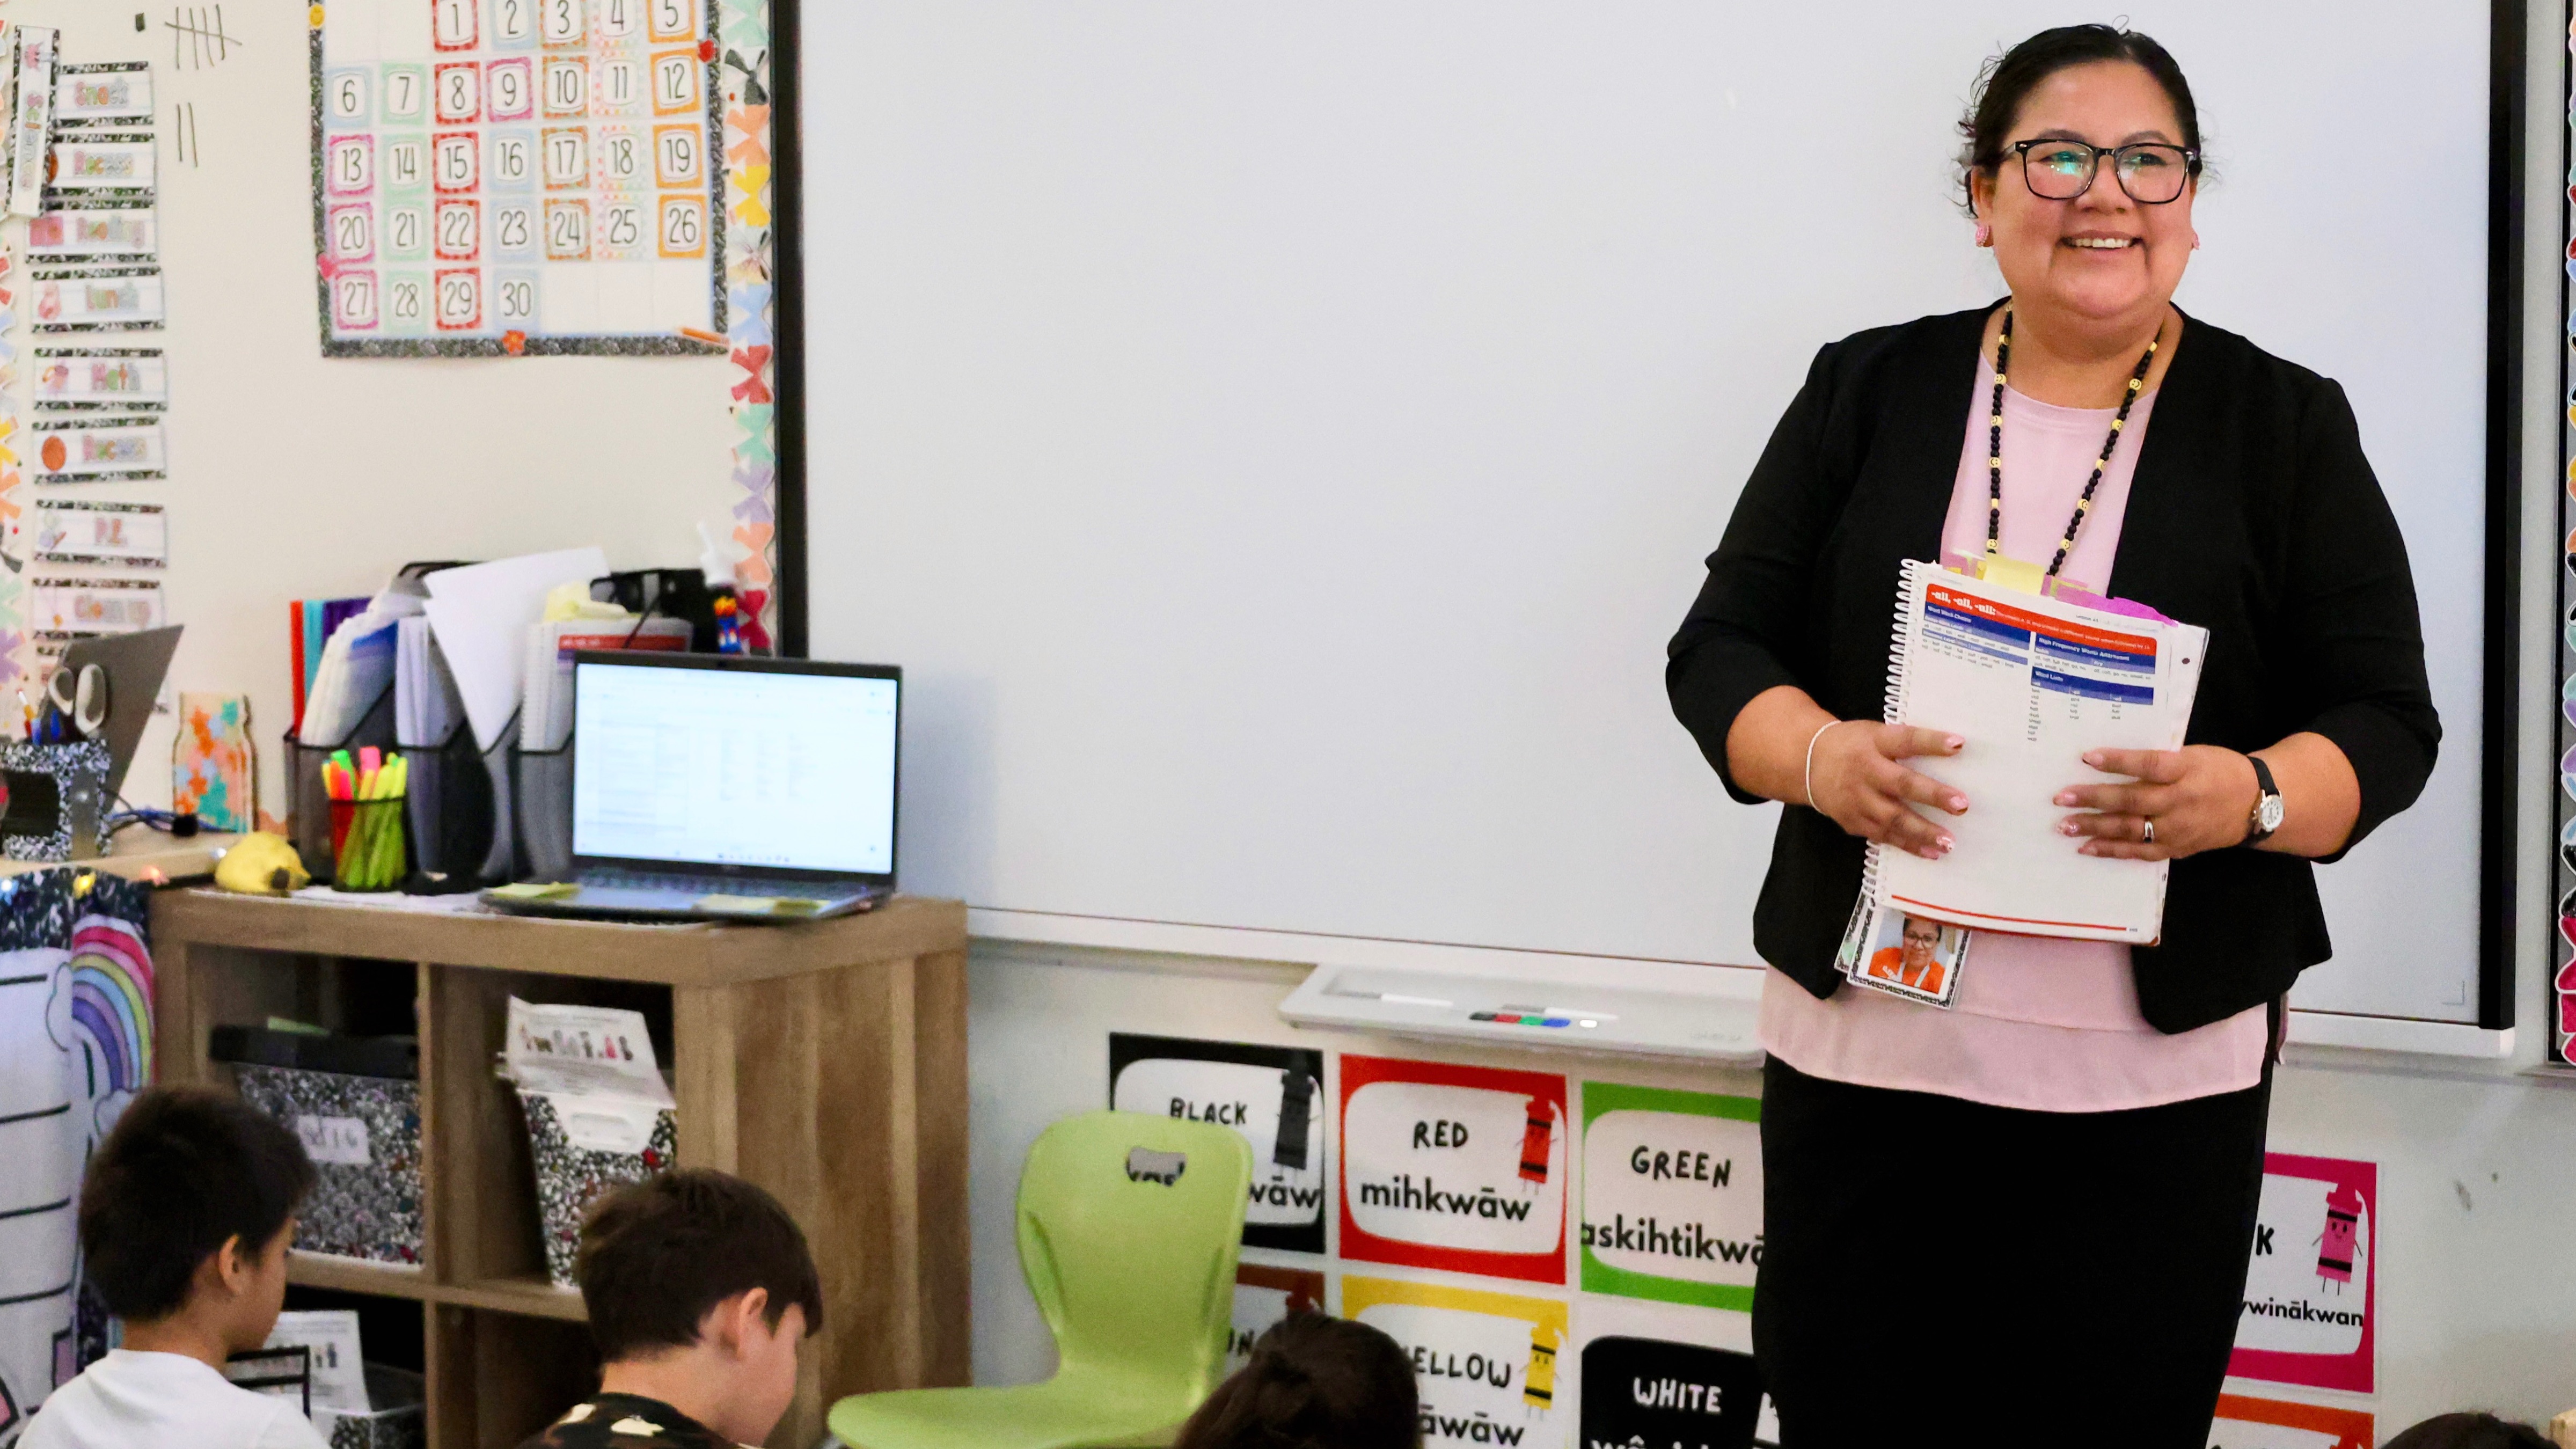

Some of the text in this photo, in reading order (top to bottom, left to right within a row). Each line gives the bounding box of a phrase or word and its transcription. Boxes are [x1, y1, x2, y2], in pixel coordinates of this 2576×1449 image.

[452, 0, 678, 35] 1 2 3 4 5
[342, 63, 685, 113] 6 7 8 9 10 11 12
[342, 138, 690, 181] 13 14 15 16 17 18 19
[340, 208, 696, 249] 20 21 22 23 24 25 26
[344, 281, 531, 317] 27 28 29 30
[1169, 1097, 1248, 1125] BLACK
[1414, 1119, 1469, 1149] RED
[1631, 1145, 1731, 1188] GREEN
[1362, 1174, 1532, 1221] mihkwāw
[1406, 1345, 1511, 1388] ELLOW
[1633, 1376, 1722, 1414] WHITE
